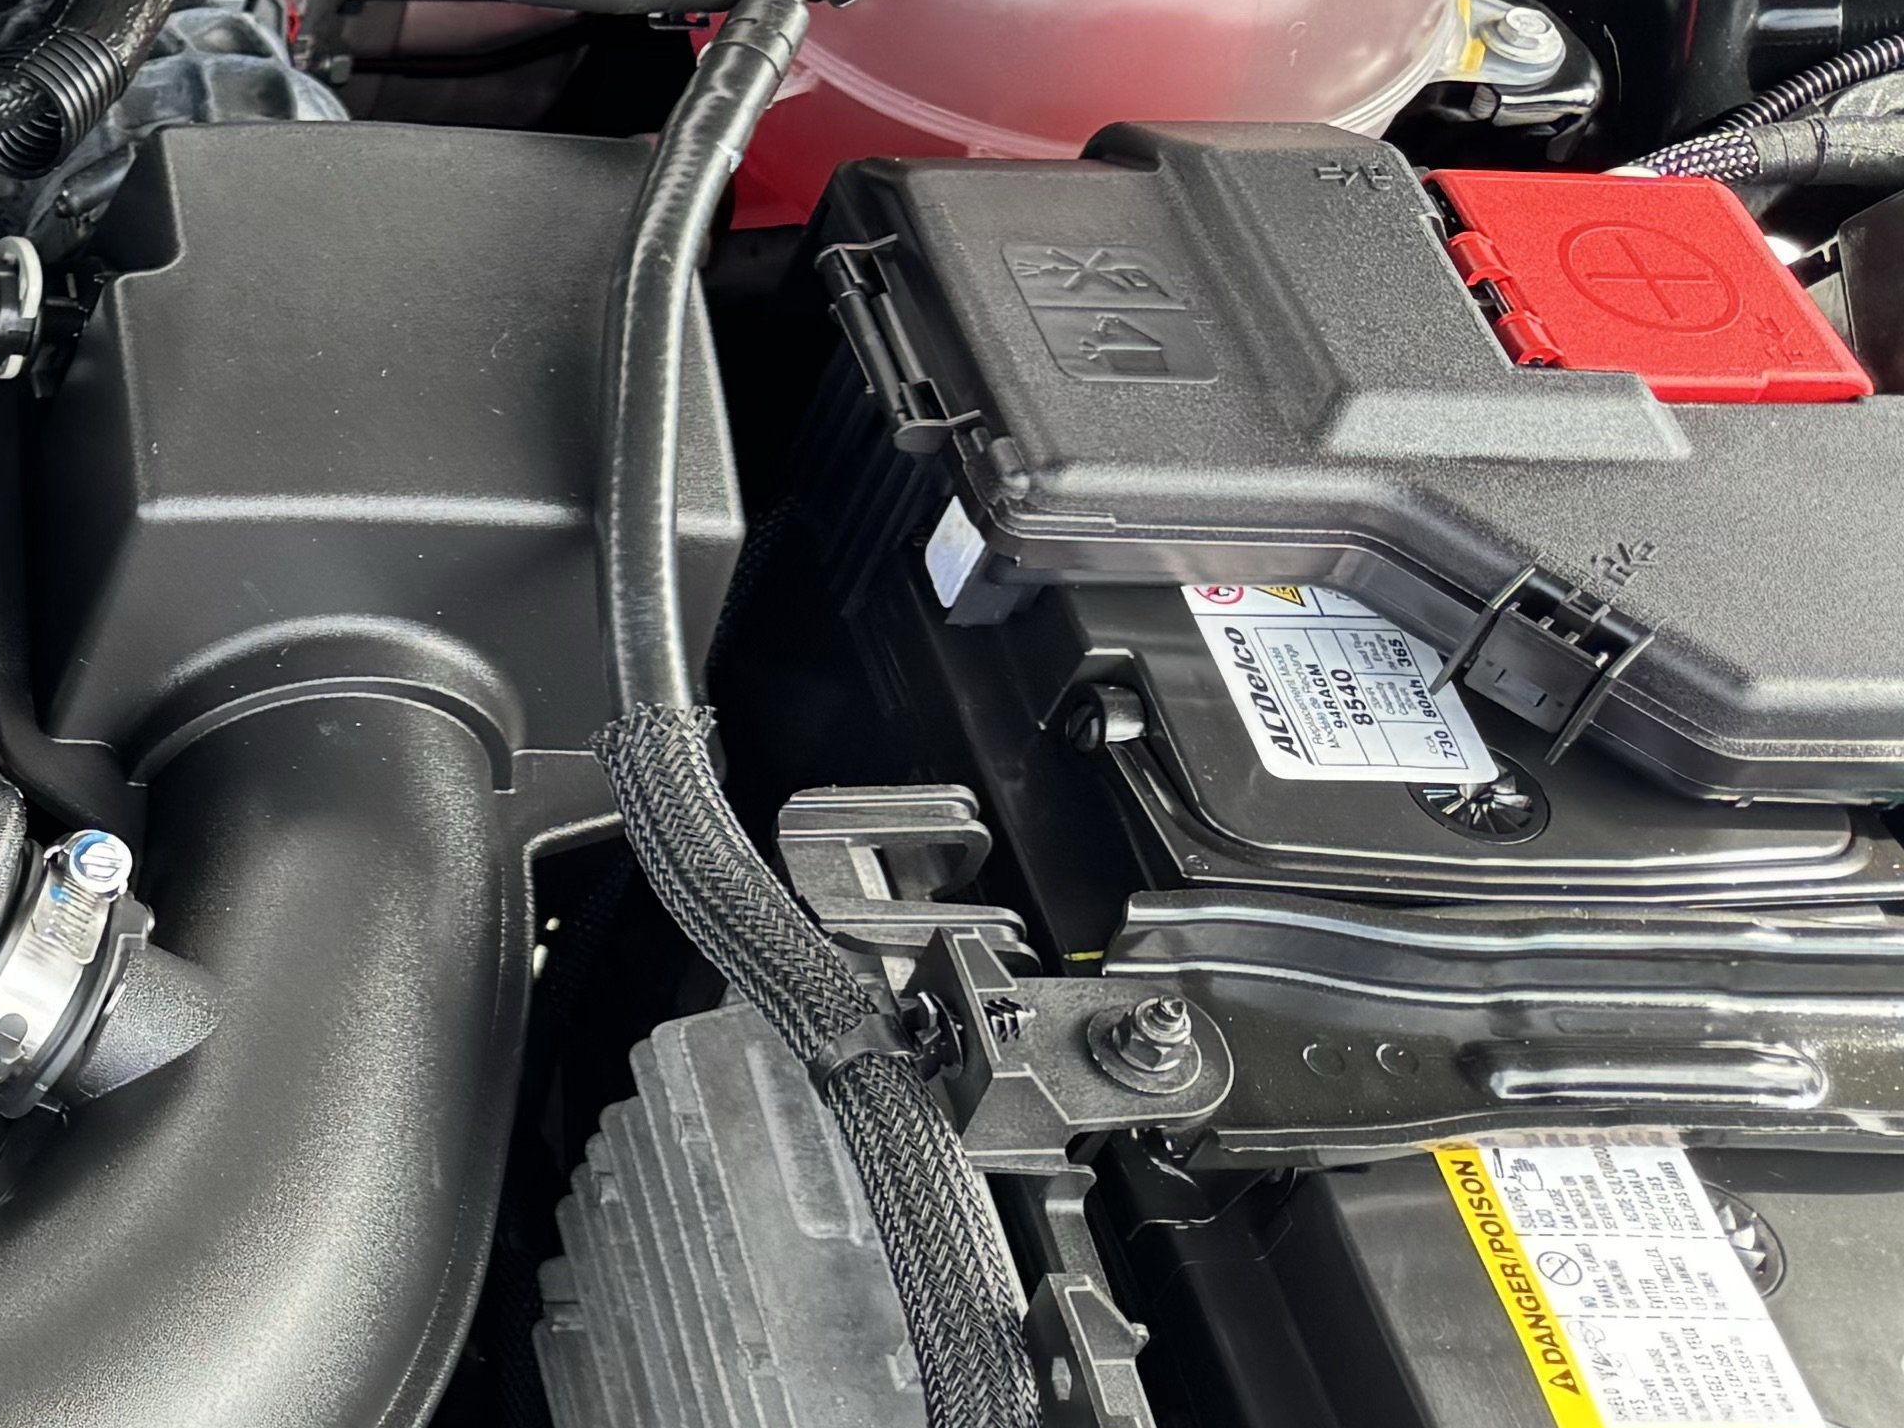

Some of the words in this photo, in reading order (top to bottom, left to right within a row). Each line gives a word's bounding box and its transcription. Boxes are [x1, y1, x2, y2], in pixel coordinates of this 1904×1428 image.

[1387, 638, 1412, 667] 365
[1224, 626, 1299, 757] ACDelco
[1304, 663, 1347, 728] 94RAGM
[1330, 668, 1374, 725] 8540
[1409, 678, 1437, 718] 80Ah
[1433, 729, 1457, 758] 730
[1451, 1159, 1569, 1367] DANGER/POISON
